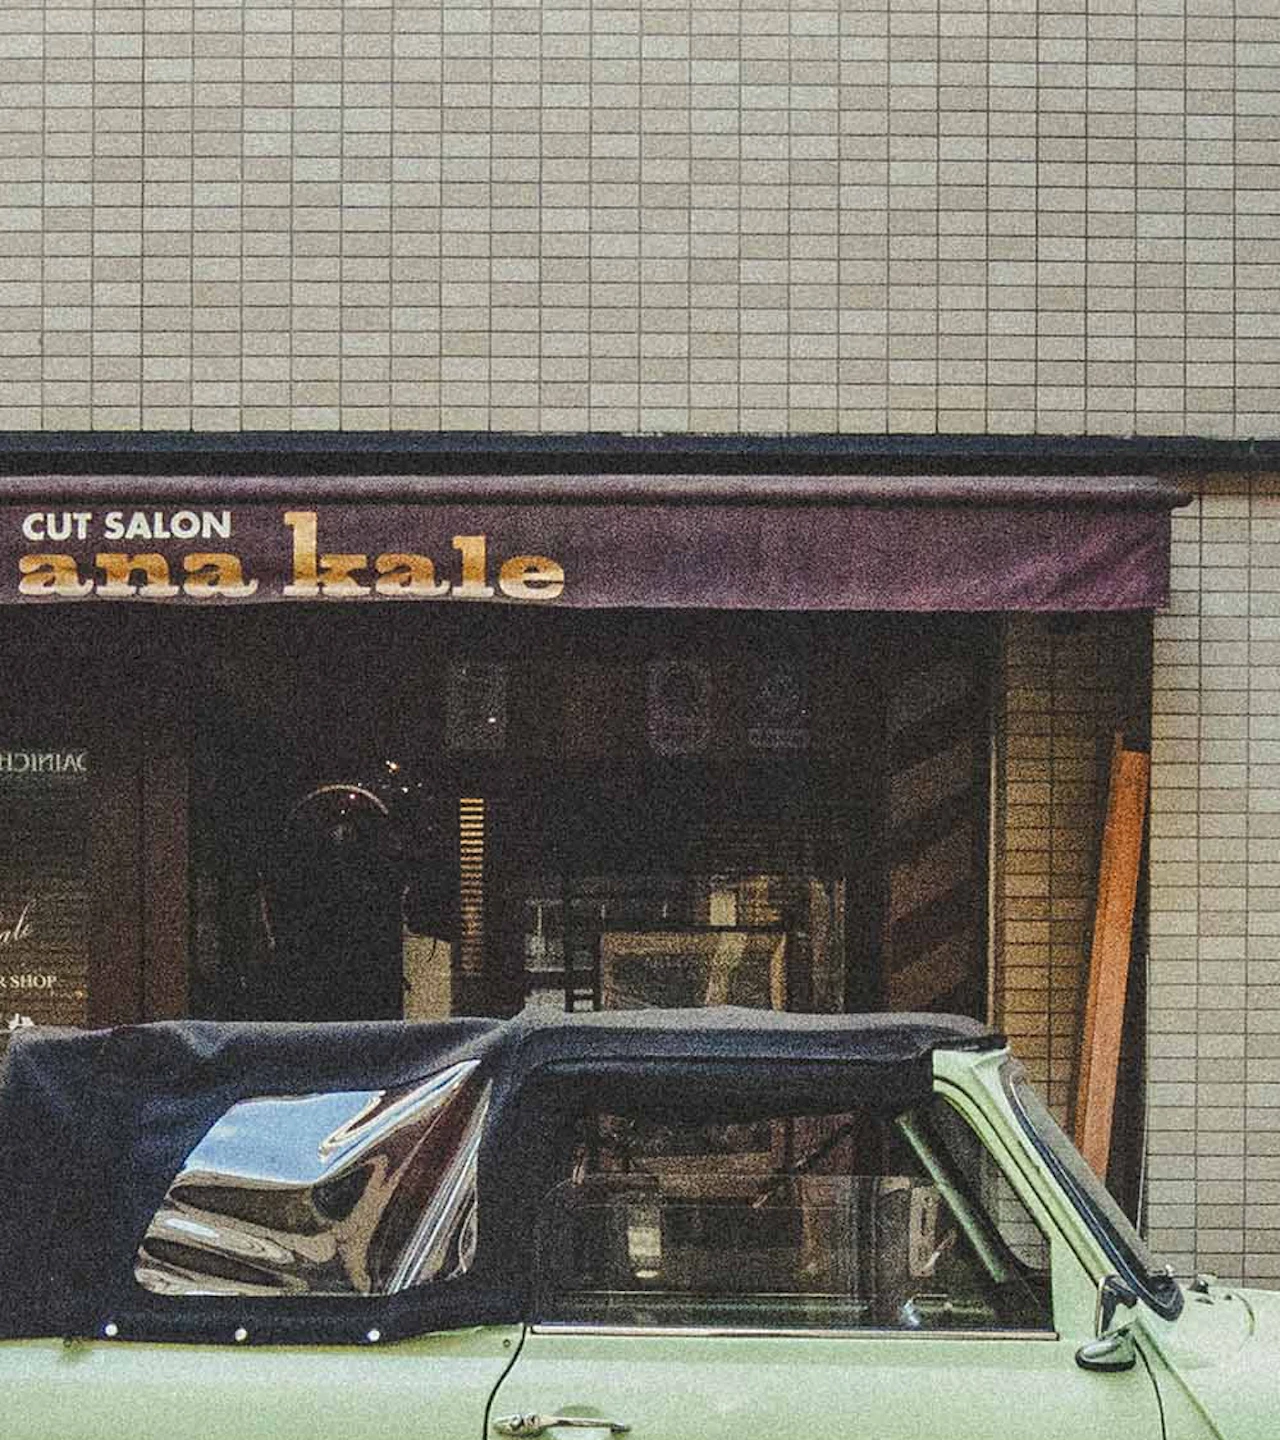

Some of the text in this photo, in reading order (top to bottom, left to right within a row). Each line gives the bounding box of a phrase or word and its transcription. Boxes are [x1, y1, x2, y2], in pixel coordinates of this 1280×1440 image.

[22, 510, 232, 541] CUT SALON
[19, 511, 565, 599] ana kale
[9, 973, 58, 990] SHOP
